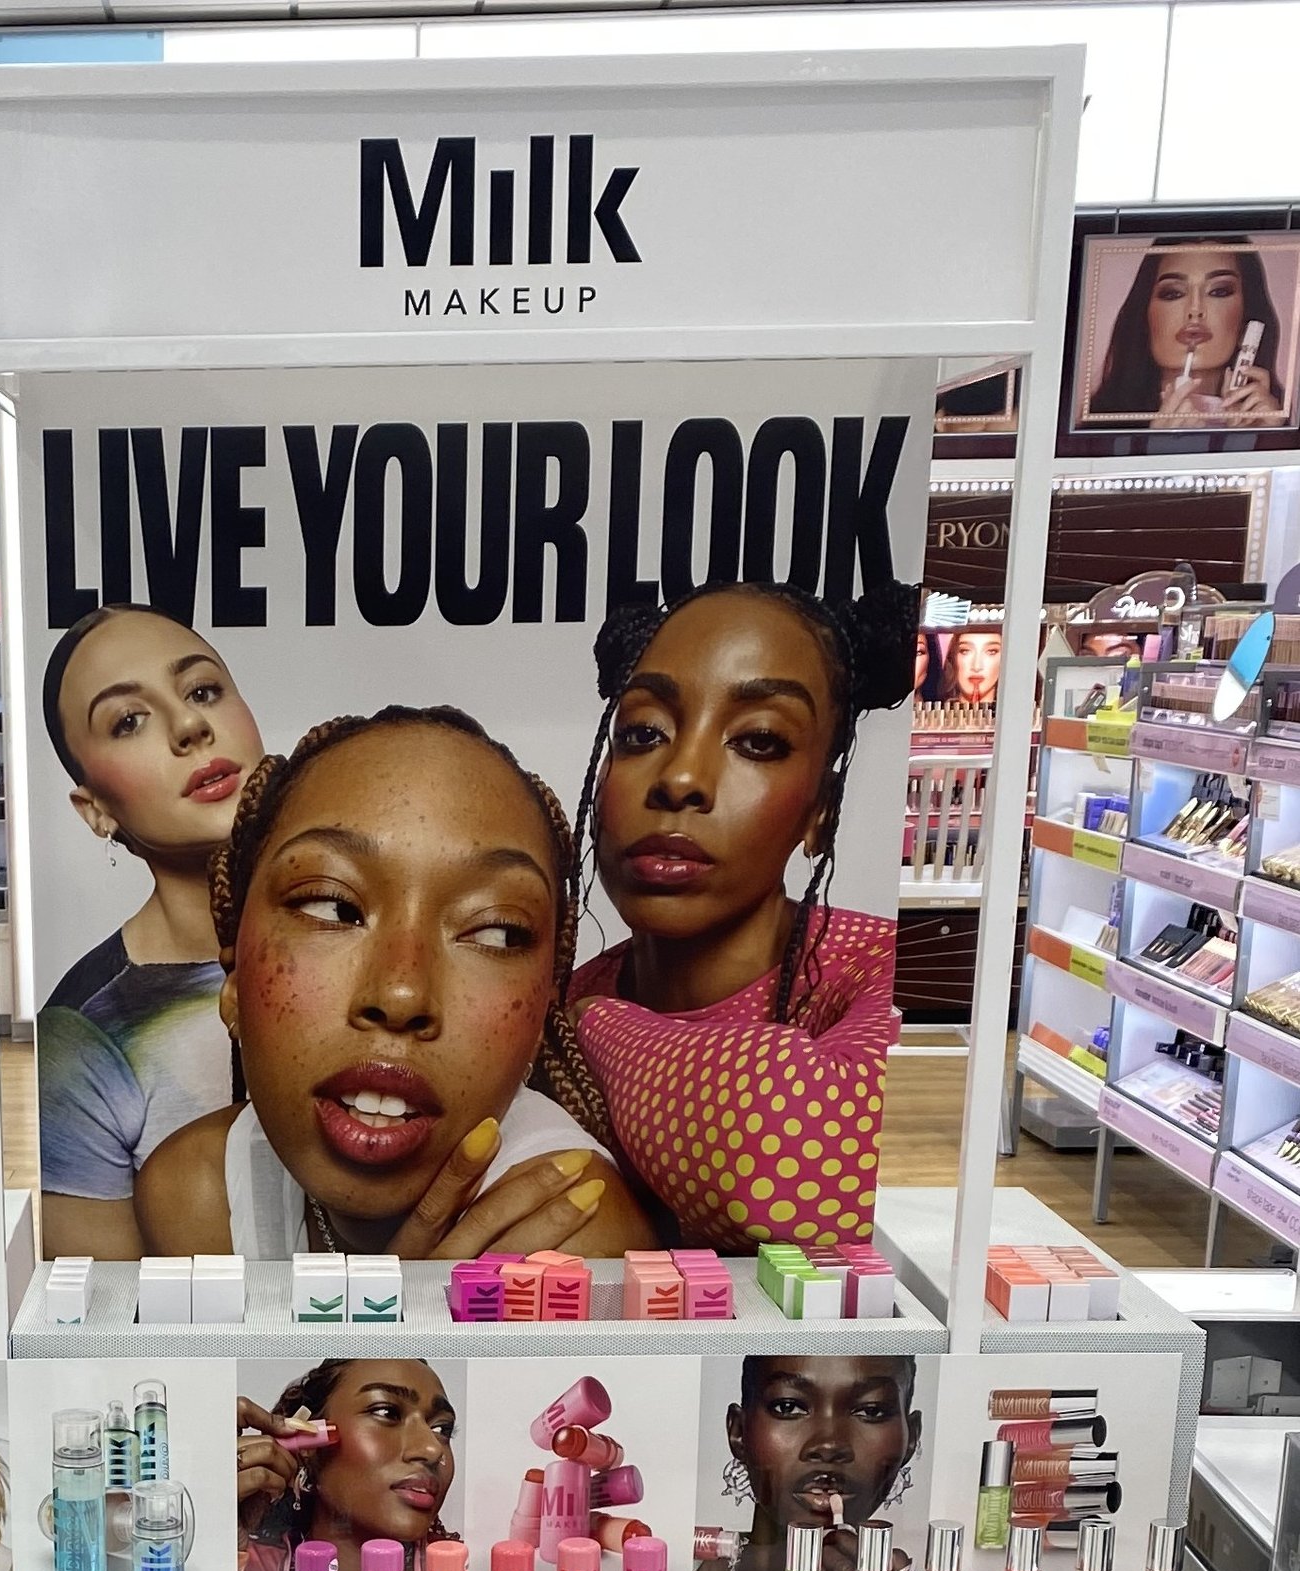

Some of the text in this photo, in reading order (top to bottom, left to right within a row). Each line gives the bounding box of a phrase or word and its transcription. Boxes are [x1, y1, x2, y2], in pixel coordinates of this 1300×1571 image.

[359, 134, 642, 269] Milk
[403, 286, 600, 317] MAKEUP
[42, 416, 912, 629] LIVE YOUR LOOK
[504, 1277, 535, 1321] ilk
[547, 1281, 580, 1320] ilk
